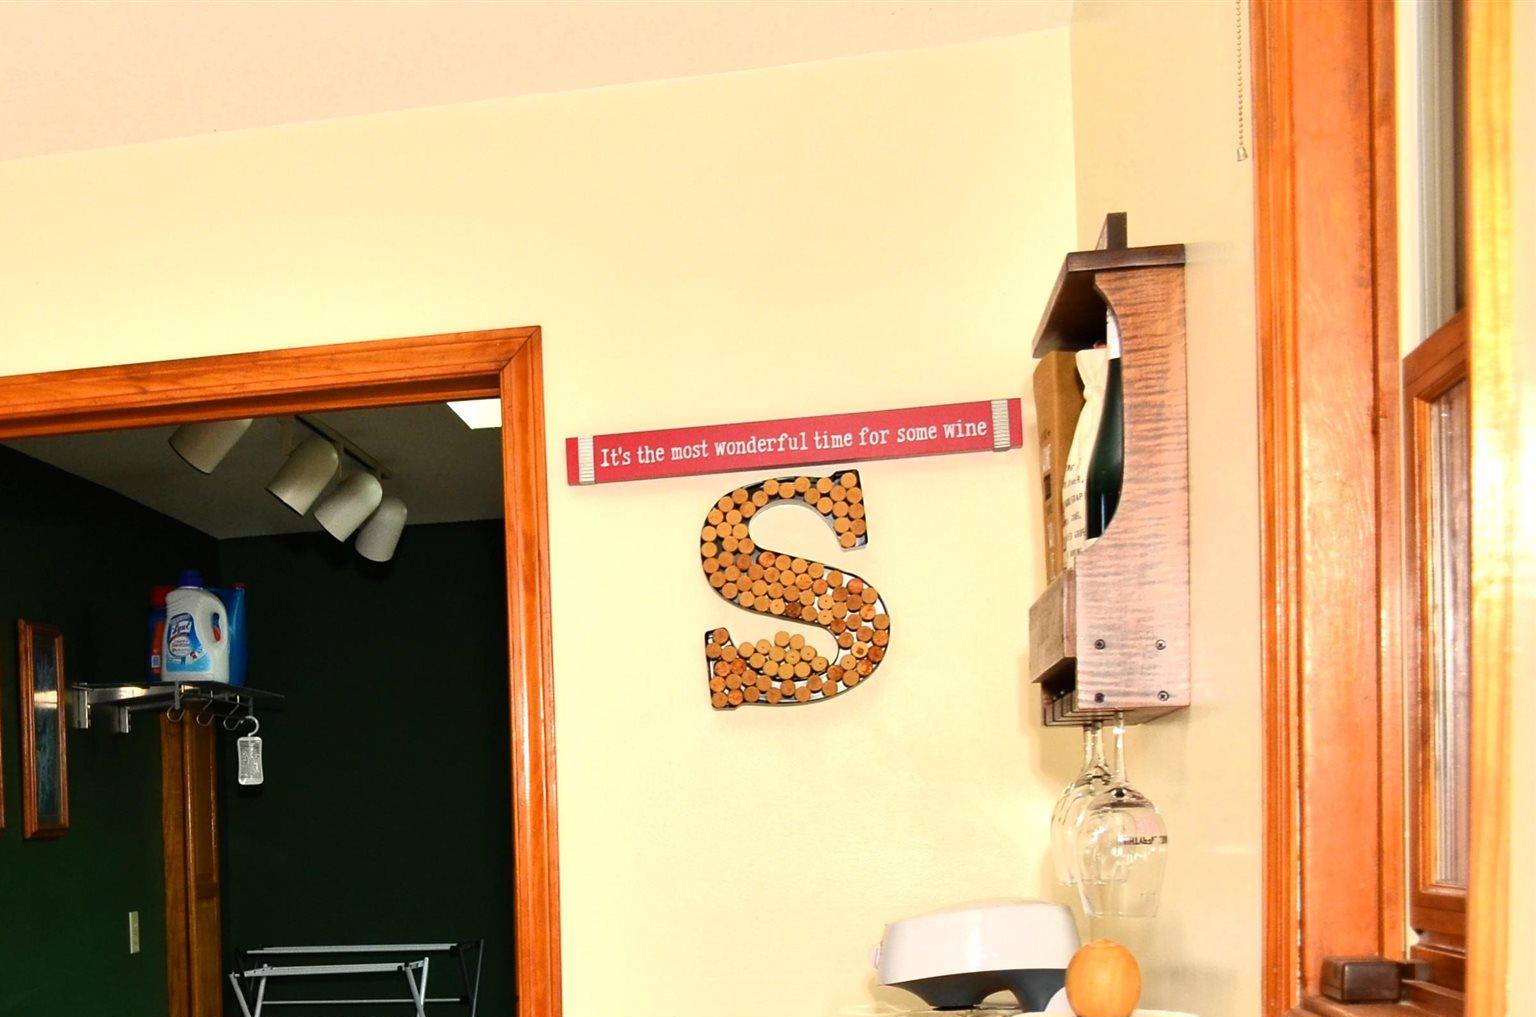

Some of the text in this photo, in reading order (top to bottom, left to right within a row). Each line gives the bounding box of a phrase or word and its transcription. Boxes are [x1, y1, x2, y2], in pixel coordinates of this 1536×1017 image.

[600, 419, 988, 468] It's the most wonderful time for some wine
